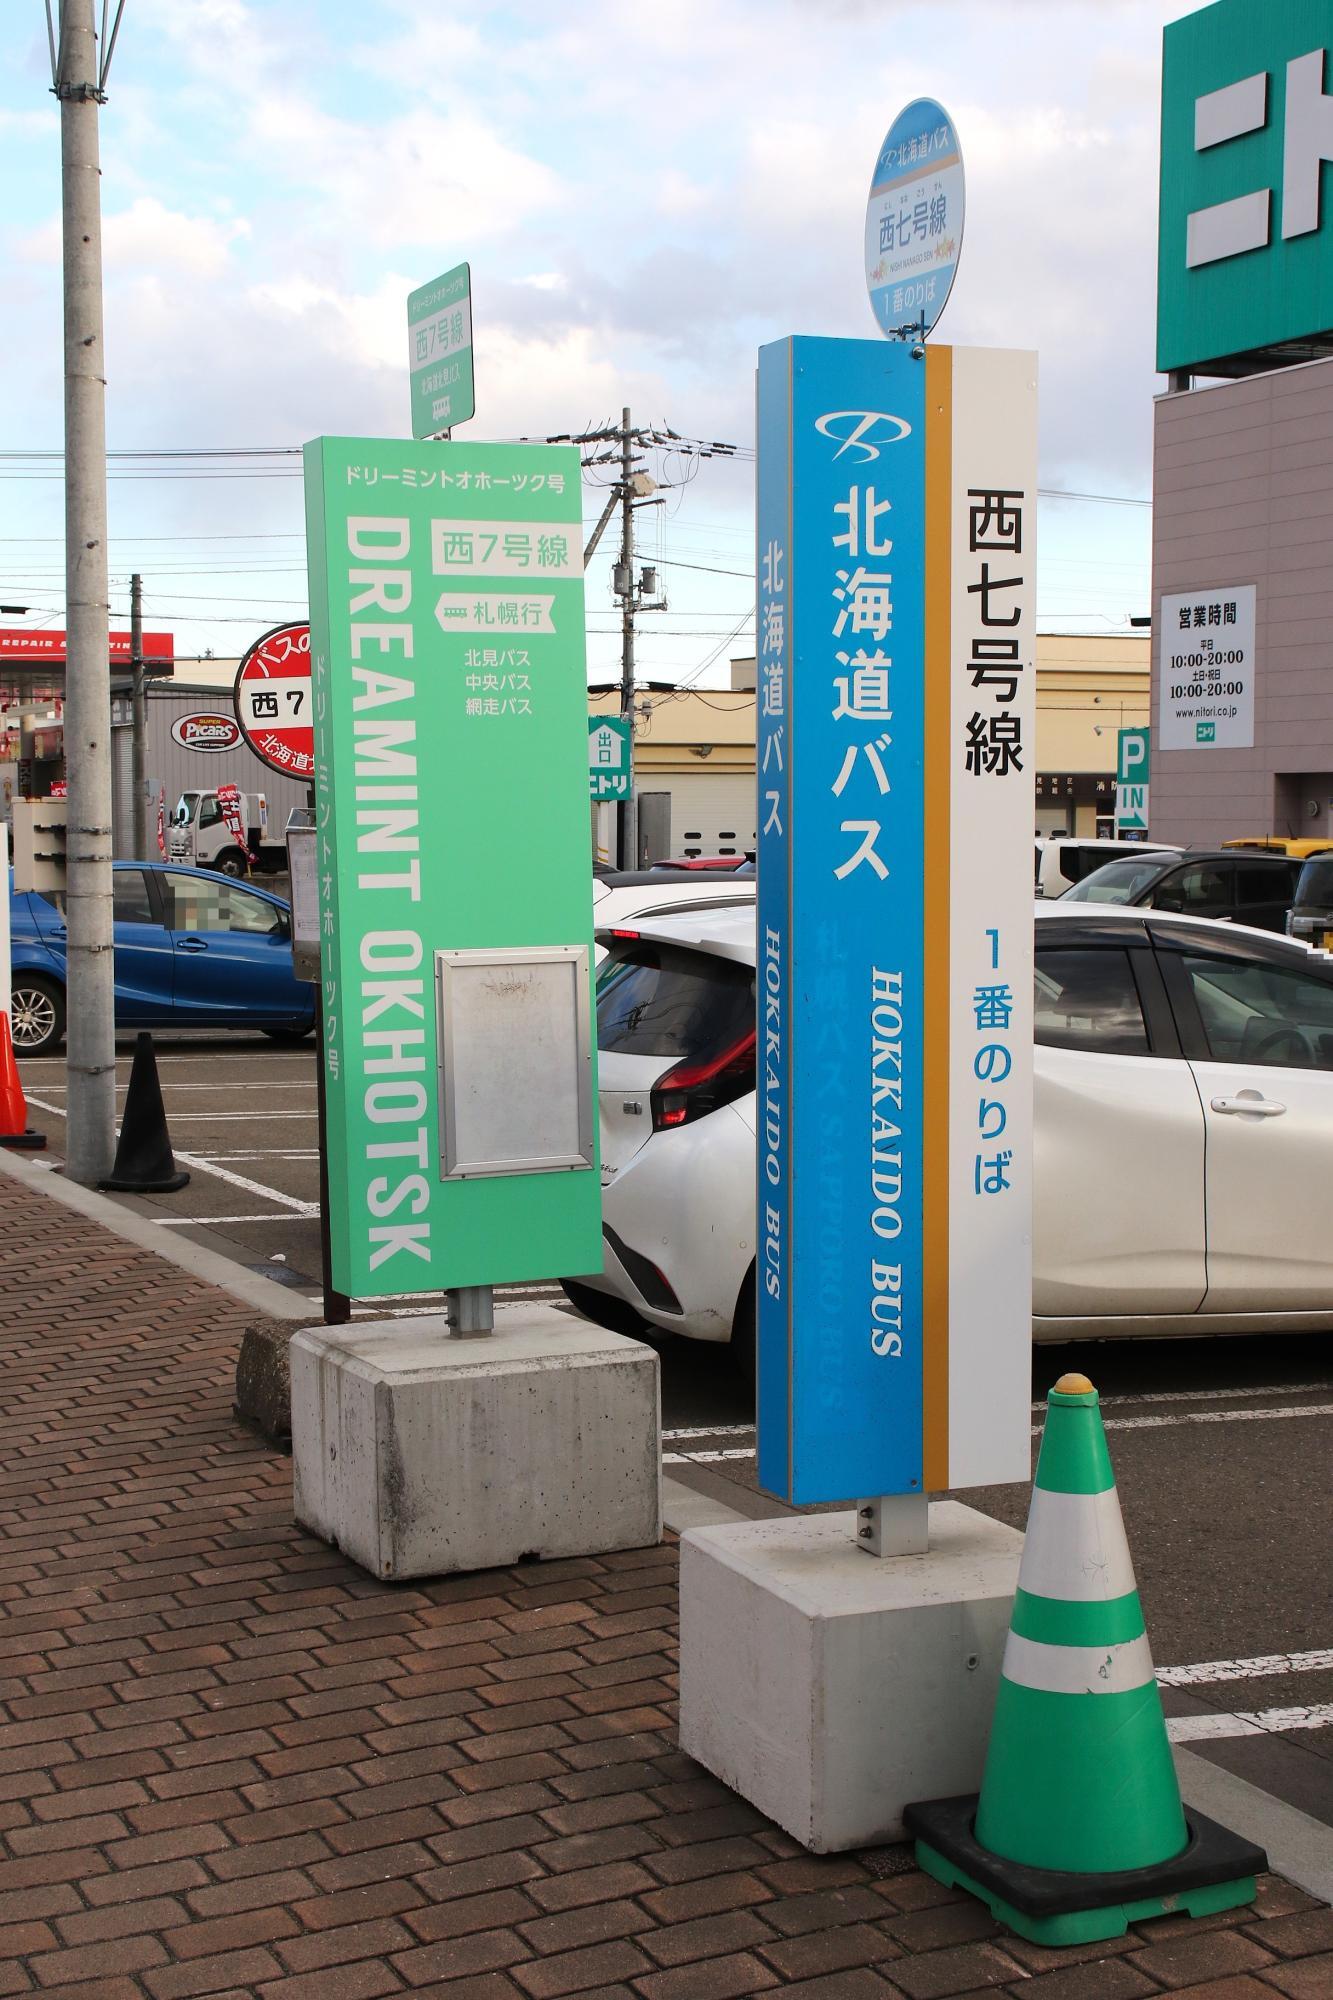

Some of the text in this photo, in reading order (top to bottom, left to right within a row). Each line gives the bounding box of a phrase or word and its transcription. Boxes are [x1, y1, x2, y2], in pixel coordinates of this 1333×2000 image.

[898, 125, 949, 168] 北海道バス
[879, 194, 947, 255] 西七号線
[884, 276, 936, 316] 1番のりば
[416, 312, 464, 362] 西7号線
[347, 466, 566, 494] ドリーミントオホーツク号
[443, 531, 569, 568] 西7号線
[474, 601, 543, 626] 札幌行
[1179, 602, 1237, 630] 営業時間
[2, 639, 54, 647] REPAIR
[965, 489, 1025, 777] 西七号線
[1200, 639, 1213, 651] 平日
[464, 649, 531, 668] 北見バス
[1170, 650, 1243, 669] 10:00-20:00
[465, 673, 532, 692] 中央バス
[762, 540, 784, 837] 北海道バス
[831, 485, 894, 881] 北海道バス
[1170, 682, 1243, 699] 10:00-20:00
[251, 691, 304, 719] 西7
[465, 698, 532, 717] 網走バス
[1176, 705, 1237, 719] www.nitori.co.jp
[599, 731, 611, 764] 出口
[1123, 735, 1145, 778] P
[1123, 788, 1143, 808] IN
[317, 655, 339, 1081] ドリーミントオホーツク号
[347, 516, 432, 1273] DREAMINT OKHOTSK
[972, 929, 1015, 1196] 1番のりば
[765, 924, 781, 1300] HOKKAIDO BUS
[871, 965, 903, 1358] HOKKAIDO BUS
